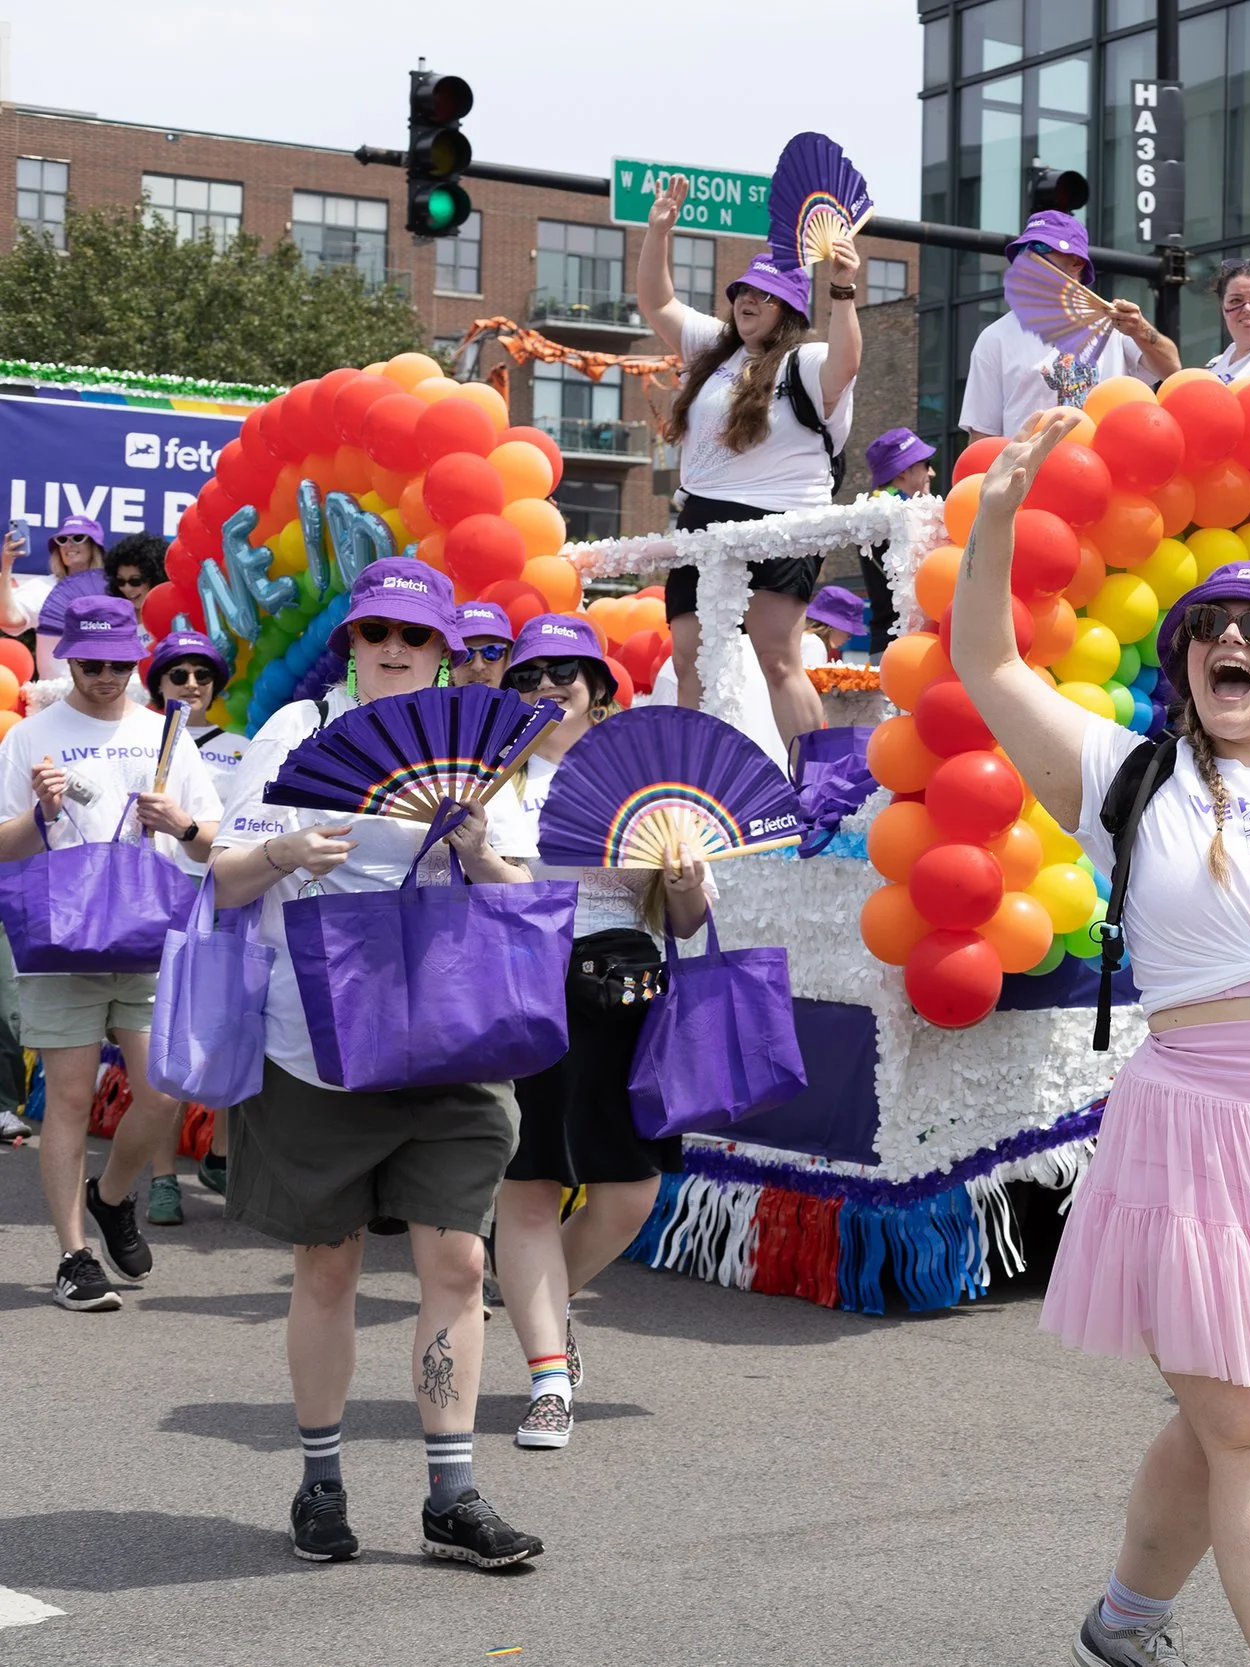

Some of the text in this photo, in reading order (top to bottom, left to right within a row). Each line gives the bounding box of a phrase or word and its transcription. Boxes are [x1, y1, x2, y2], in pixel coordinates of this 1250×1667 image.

[1133, 83, 1158, 242] HA3601
[620, 169, 767, 206] W ADISON ST
[720, 208, 732, 226] N
[10, 478, 146, 535] LIVE
[396, 577, 428, 594] fetch
[472, 609, 495, 620] fetch
[88, 621, 112, 631] fetch
[551, 626, 578, 641] fetch
[61, 747, 102, 763] LIVE
[247, 819, 284, 833] fetch
[764, 813, 798, 833] fetch
